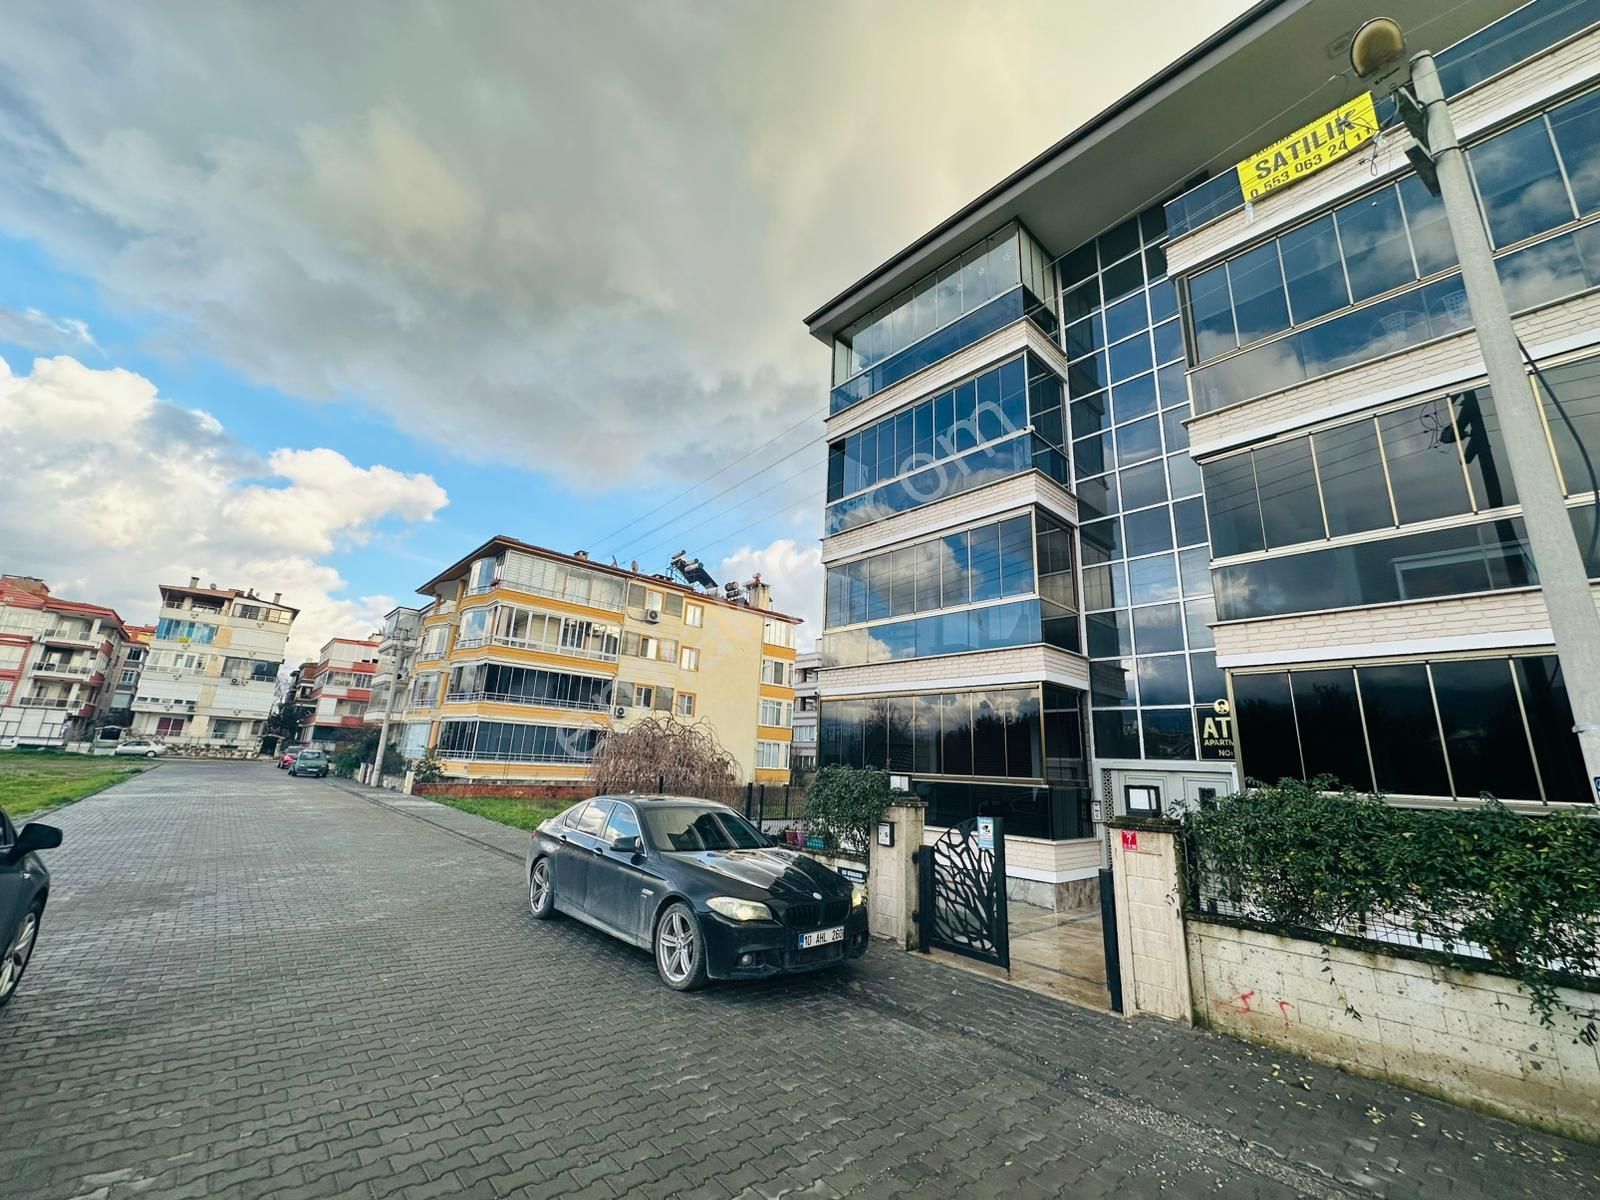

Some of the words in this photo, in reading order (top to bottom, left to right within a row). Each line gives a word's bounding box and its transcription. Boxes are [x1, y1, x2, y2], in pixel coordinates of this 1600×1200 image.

[1255, 109, 1356, 179] SATILIK
[1264, 171, 1289, 189] 553
[1295, 153, 1322, 173] 063
[1328, 140, 1347, 157] 24
[804, 935, 812, 946] 10
[815, 932, 827, 944] AHL
